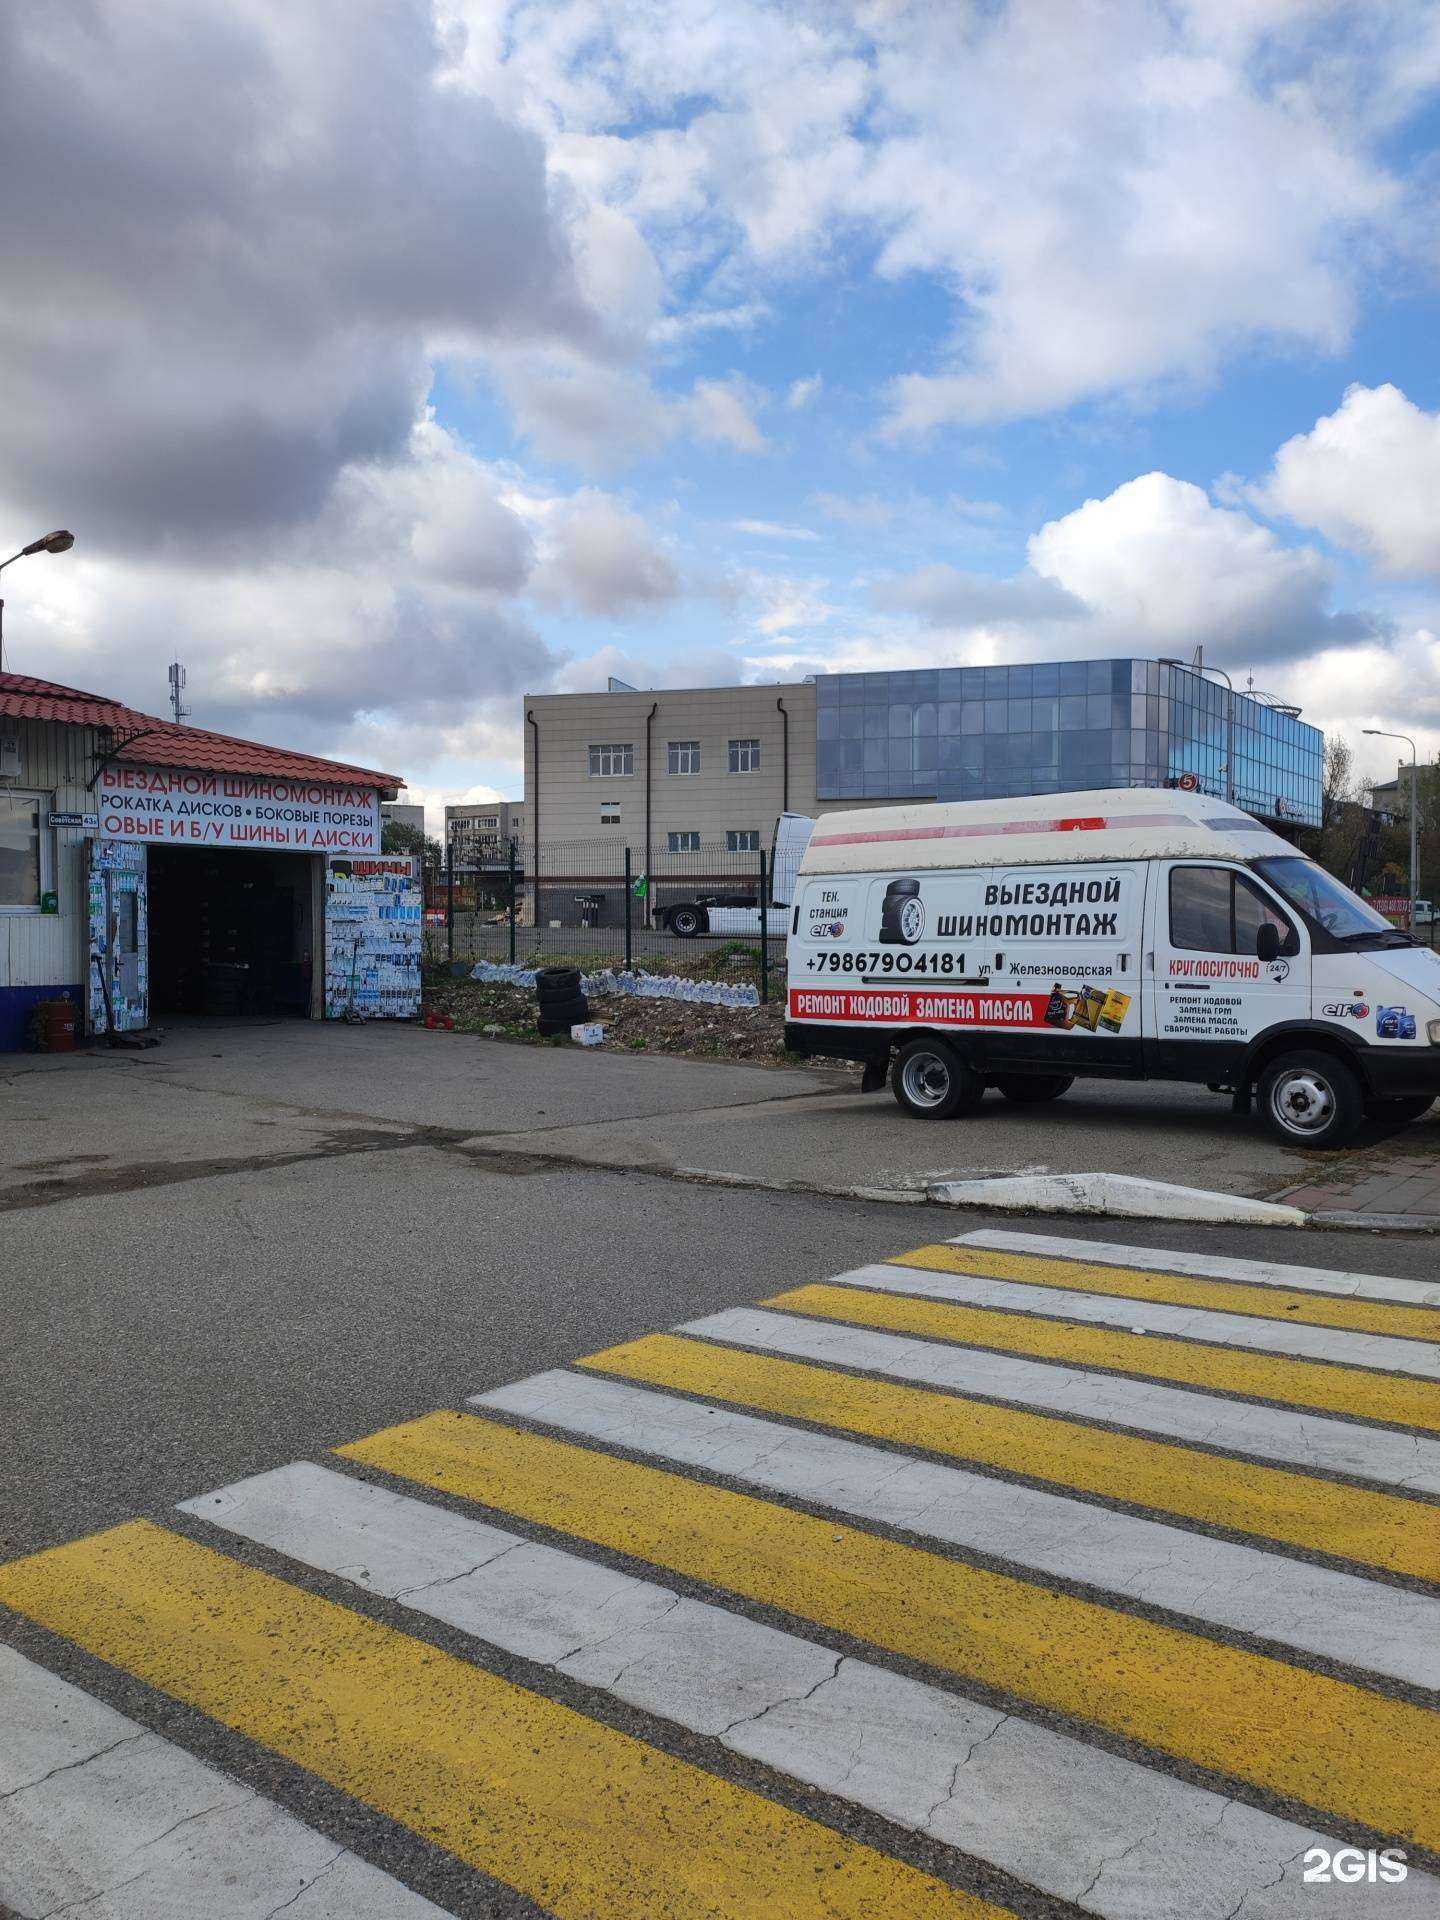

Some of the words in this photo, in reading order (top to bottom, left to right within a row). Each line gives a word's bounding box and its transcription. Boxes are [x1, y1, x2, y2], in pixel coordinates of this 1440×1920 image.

[223, 778, 372, 809] ШИНОМОНТАЖ
[177, 801, 242, 817] ДИСКОВ
[255, 806, 319, 823] БОКОВЫЕ
[323, 811, 373, 827] ПОРЕЗЫ
[170, 819, 184, 837] И
[190, 821, 225, 841] Б/У
[230, 822, 290, 843] ШИНЫ
[295, 827, 307, 844] И
[311, 828, 373, 848] ДИСКИ
[353, 860, 412, 877] ШИНЫ
[985, 876, 1121, 907] ВЫЕЗДНОЙ
[810, 924, 833, 938] elf
[937, 913, 1118, 937] ШИНОМОНТАЖ
[806, 952, 965, 973] +79867904181
[978, 964, 994, 979] ул.
[1009, 962, 1112, 978] Железноводская
[1169, 959, 1260, 979] КРУГЛОСУТОЧНО
[1270, 964, 1286, 973] 24/7
[798, 994, 846, 1015] РЕМОНТ
[850, 993, 910, 1018] ХОДОВОЙ
[916, 998, 975, 1019] ЗАМЕНА
[980, 1000, 1034, 1022] МАСЛА
[1170, 996, 1201, 1004] РЕМОНТ
[1203, 997, 1242, 1006] ХОДОВОЙ
[1179, 1006, 1212, 1014] ЗАМЕНА
[1322, 1003, 1353, 1018] elf
[1173, 1015, 1206, 1024] ЗАМЕНА
[1208, 1017, 1238, 1025] МАСЛА
[1164, 1025, 1212, 1034] СВАРОЧНЫЕ
[1214, 1027, 1248, 1035] РАБОТЫ
